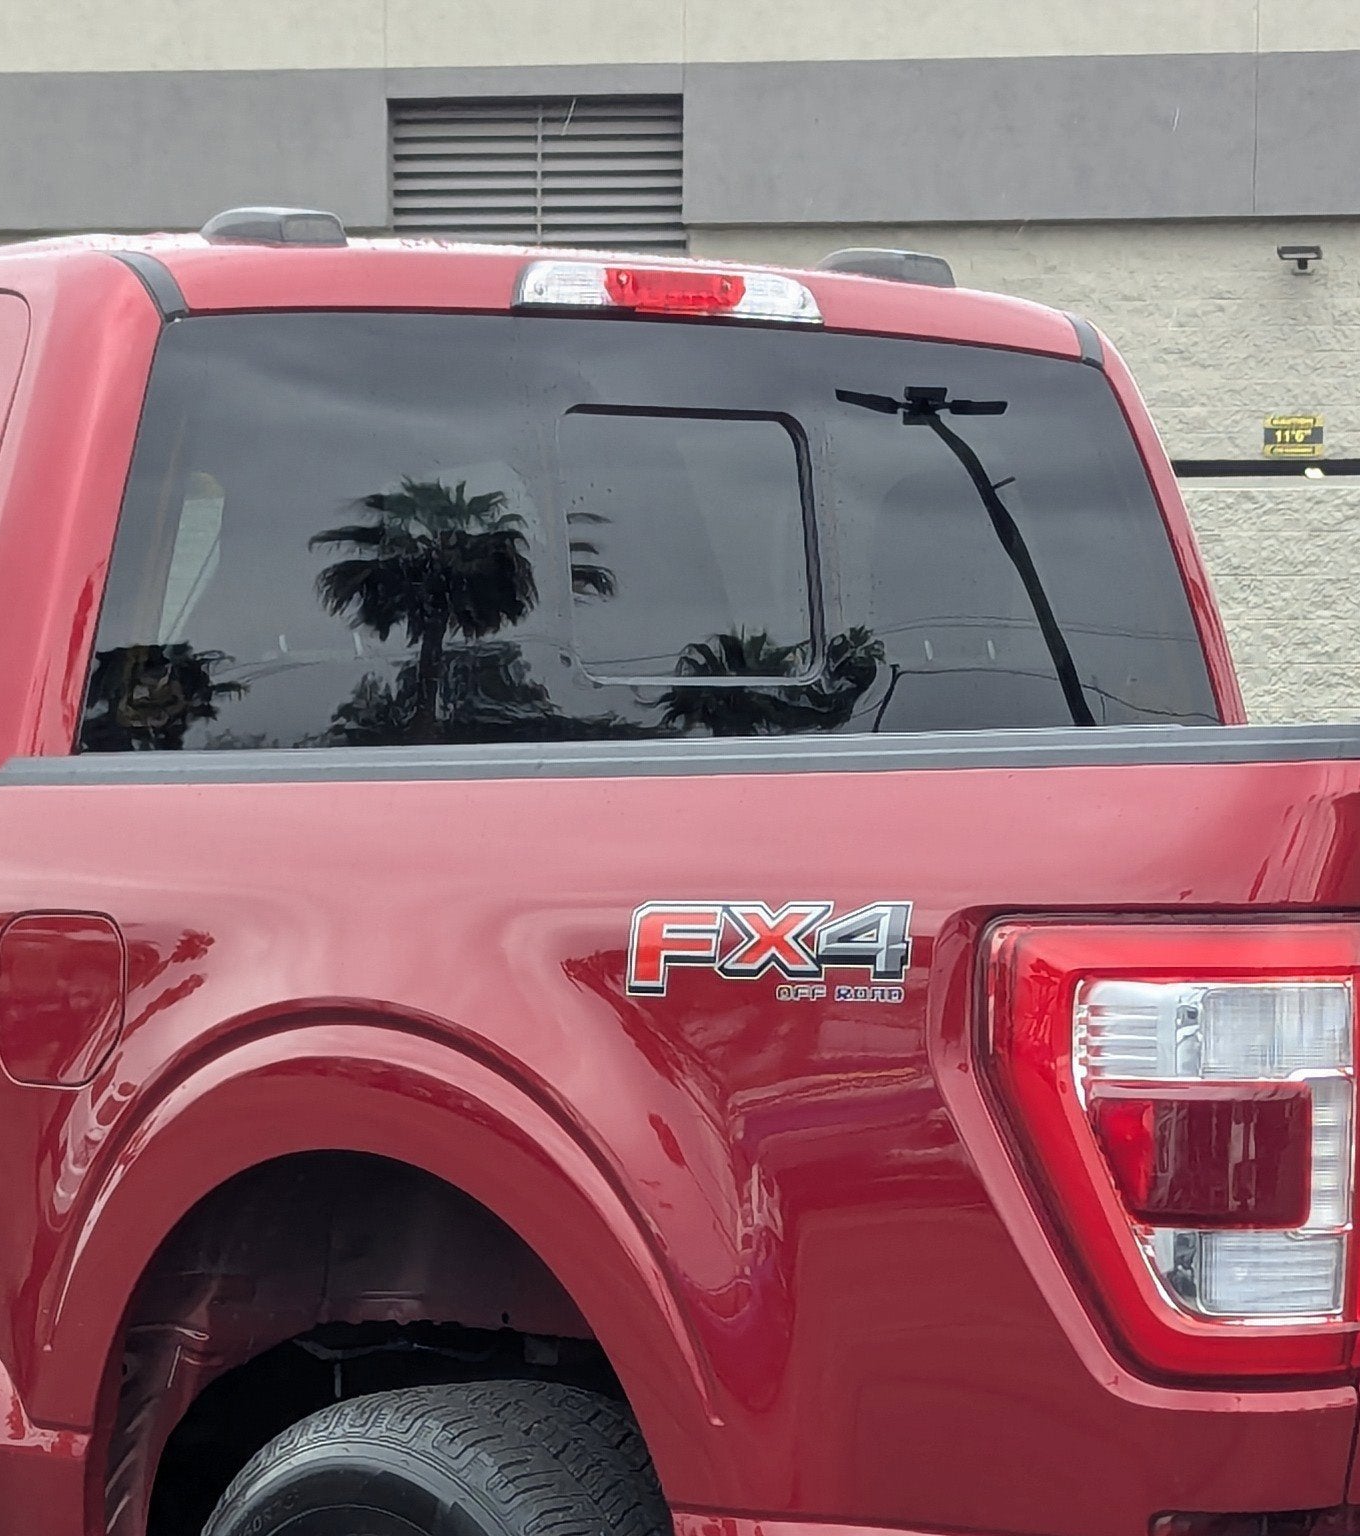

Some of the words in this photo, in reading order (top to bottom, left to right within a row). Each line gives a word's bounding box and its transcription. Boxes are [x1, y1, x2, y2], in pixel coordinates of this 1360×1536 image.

[626, 900, 913, 996] FX4
[776, 984, 827, 1001] OFF
[834, 986, 905, 1003] ROAD
